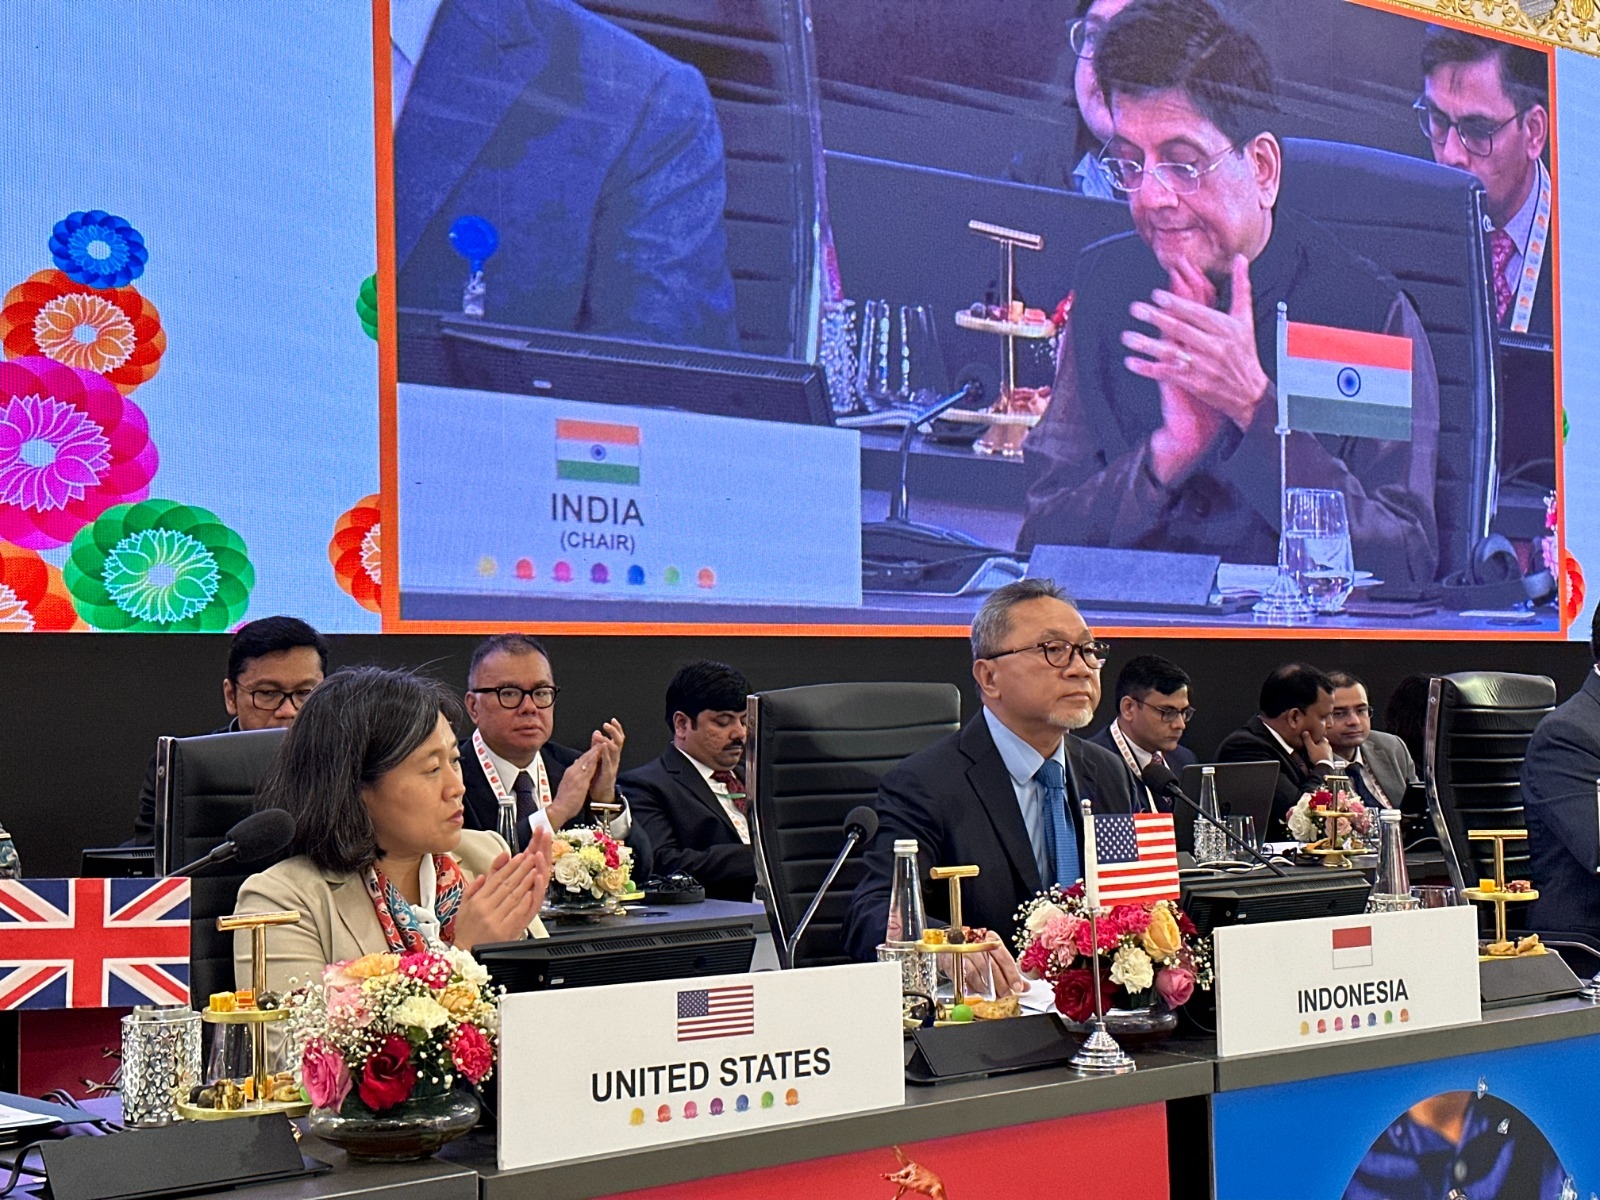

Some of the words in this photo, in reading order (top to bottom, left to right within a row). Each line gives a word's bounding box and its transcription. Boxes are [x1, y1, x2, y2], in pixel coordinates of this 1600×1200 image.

[551, 492, 644, 526] INDIA
[560, 531, 635, 554] (CHAIR)
[1297, 978, 1409, 1013] INDONESIA
[592, 1061, 709, 1102] UNITED
[720, 1046, 831, 1086] STATES
